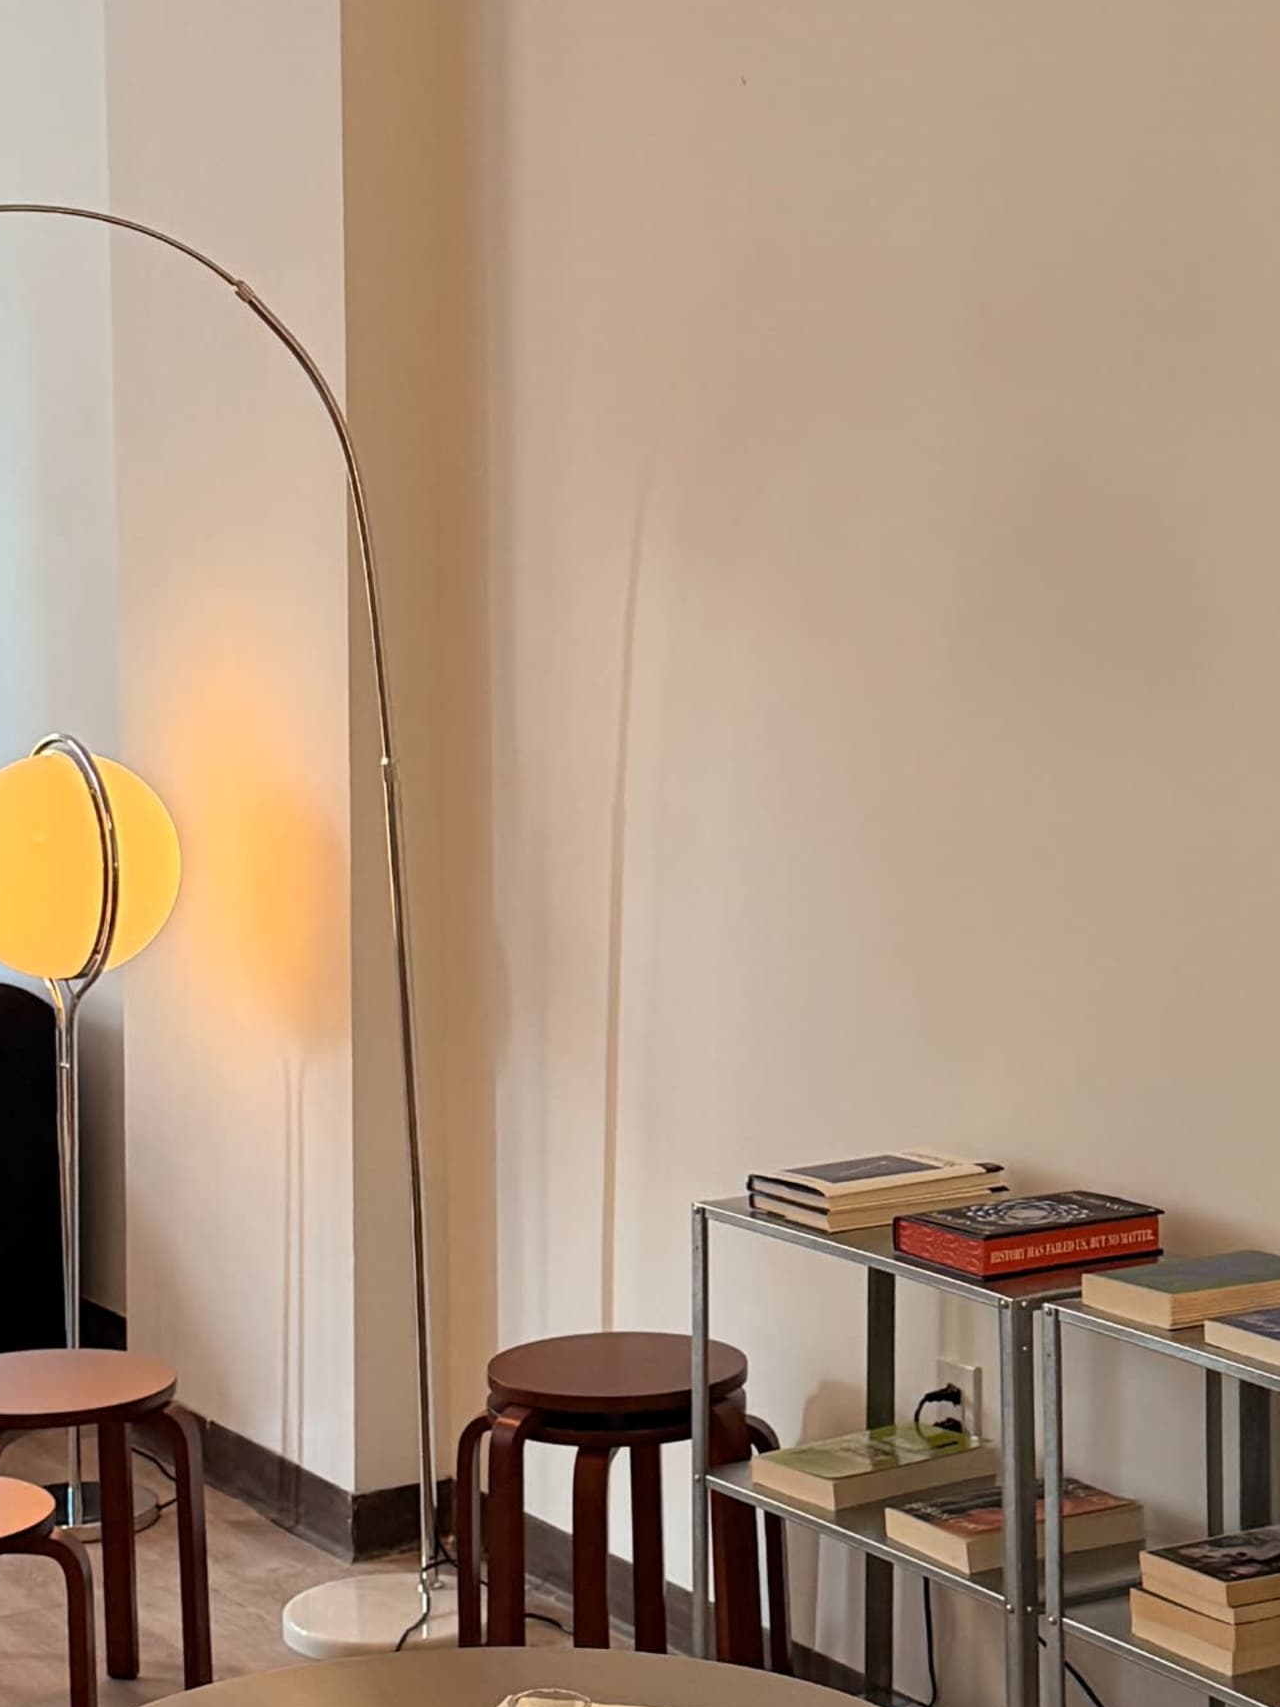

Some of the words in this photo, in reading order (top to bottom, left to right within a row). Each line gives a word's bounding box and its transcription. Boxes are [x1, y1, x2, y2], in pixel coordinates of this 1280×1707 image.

[990, 1249, 1025, 1264] HISTORY
[1026, 1246, 1044, 1258] HAS
[1045, 1242, 1075, 1256] FAILED
[1089, 1236, 1106, 1249] BUT
[1107, 1234, 1120, 1246] NO
[1119, 1229, 1157, 1245] MATTER.
